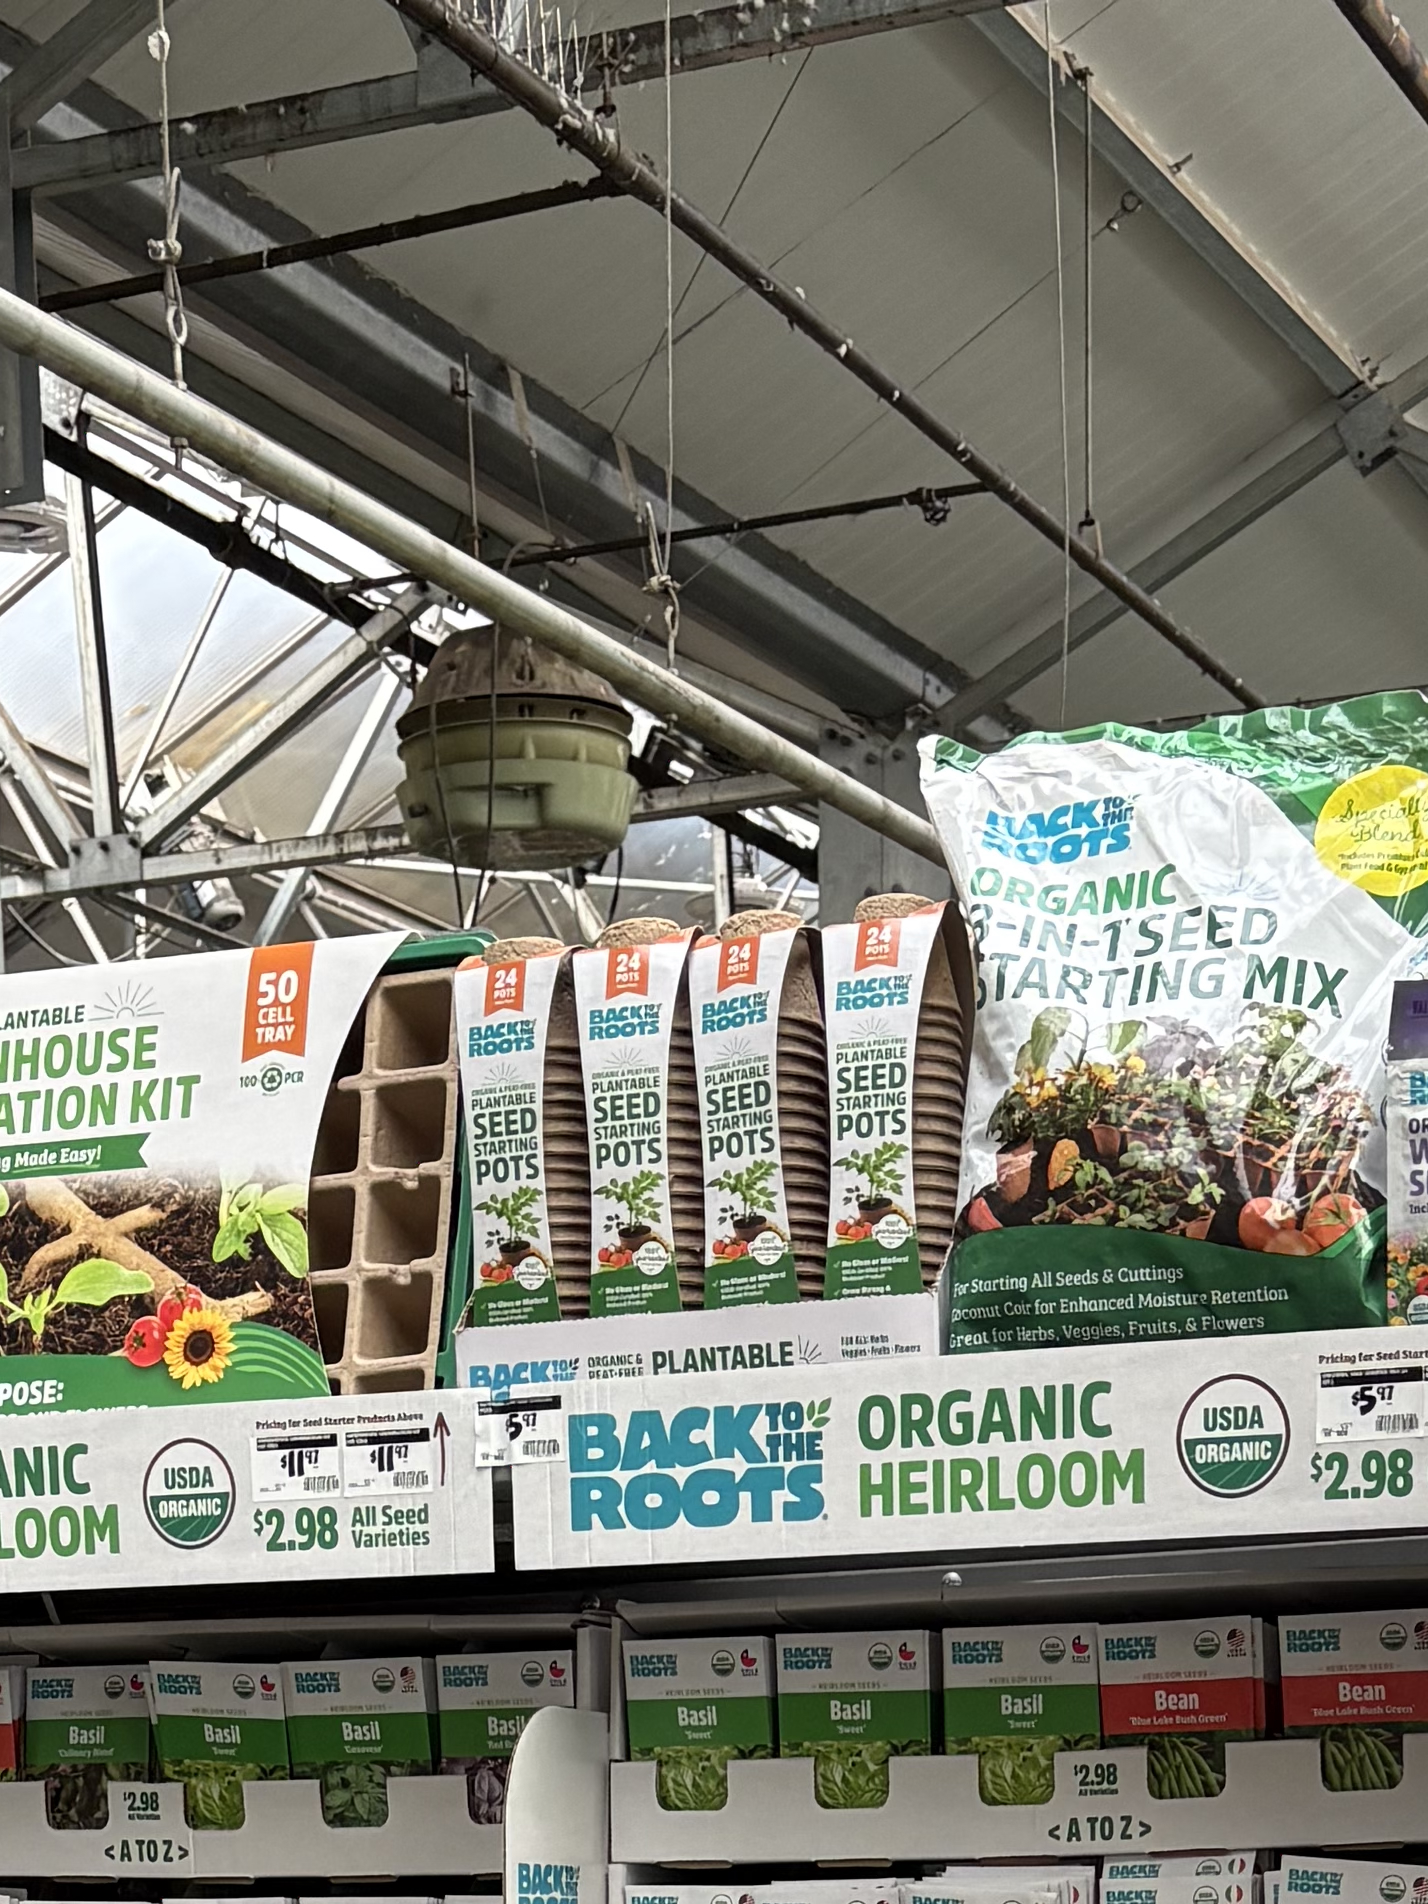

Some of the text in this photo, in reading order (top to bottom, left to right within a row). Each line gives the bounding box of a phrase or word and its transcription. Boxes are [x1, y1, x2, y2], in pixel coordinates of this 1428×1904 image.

[971, 863, 1176, 917] ORGANIC
[867, 926, 891, 945] 24
[1133, 906, 1278, 958] SEED
[258, 970, 298, 1006] 50
[836, 979, 891, 997] BACK
[1243, 954, 1348, 1019] MIX
[259, 1006, 293, 1024] CELL
[836, 991, 907, 1011] ROOTS
[256, 1025, 295, 1043] TRAY
[836, 1046, 908, 1064] PLANTABLE
[837, 1062, 906, 1094] SEED
[131, 1076, 198, 1122] KIT
[836, 1091, 906, 1111] STARTING
[837, 1109, 906, 1141] POTS
[14, 1150, 56, 1168] Made
[59, 1145, 101, 1167] Easy!
[954, 1265, 1183, 1297] For Starting All Seeds Cuttings
[1004, 1286, 1288, 1315] Coir for Enhanced Moisture Retention
[950, 1316, 1264, 1348] Great for Herbs, Veggies, Fruits, Flowers
[652, 1341, 794, 1375] PLANTABLE
[1319, 1353, 1356, 1364] Pricing
[1359, 1352, 1374, 1362] for
[1376, 1350, 1400, 1361] Seed
[858, 1383, 1109, 1450] ORGANIC
[1204, 1405, 1264, 1432] USDA
[569, 1404, 820, 1472] BACK TO THE
[1195, 1439, 1273, 1465] ORGANIC
[164, 1466, 214, 1490] USDA
[860, 1449, 1143, 1516] HEIRLOOM
[1311, 1449, 1413, 1500] $2.98
[158, 1498, 221, 1518] ORGANIC
[571, 1465, 823, 1531] ROOTS
[254, 1503, 429, 1552] $2.98 All Seed
[352, 1527, 430, 1548] Varieties
[1155, 1690, 1198, 1710] Bean
[204, 1724, 240, 1743] Basil
[124, 1792, 159, 1811] $2.98
